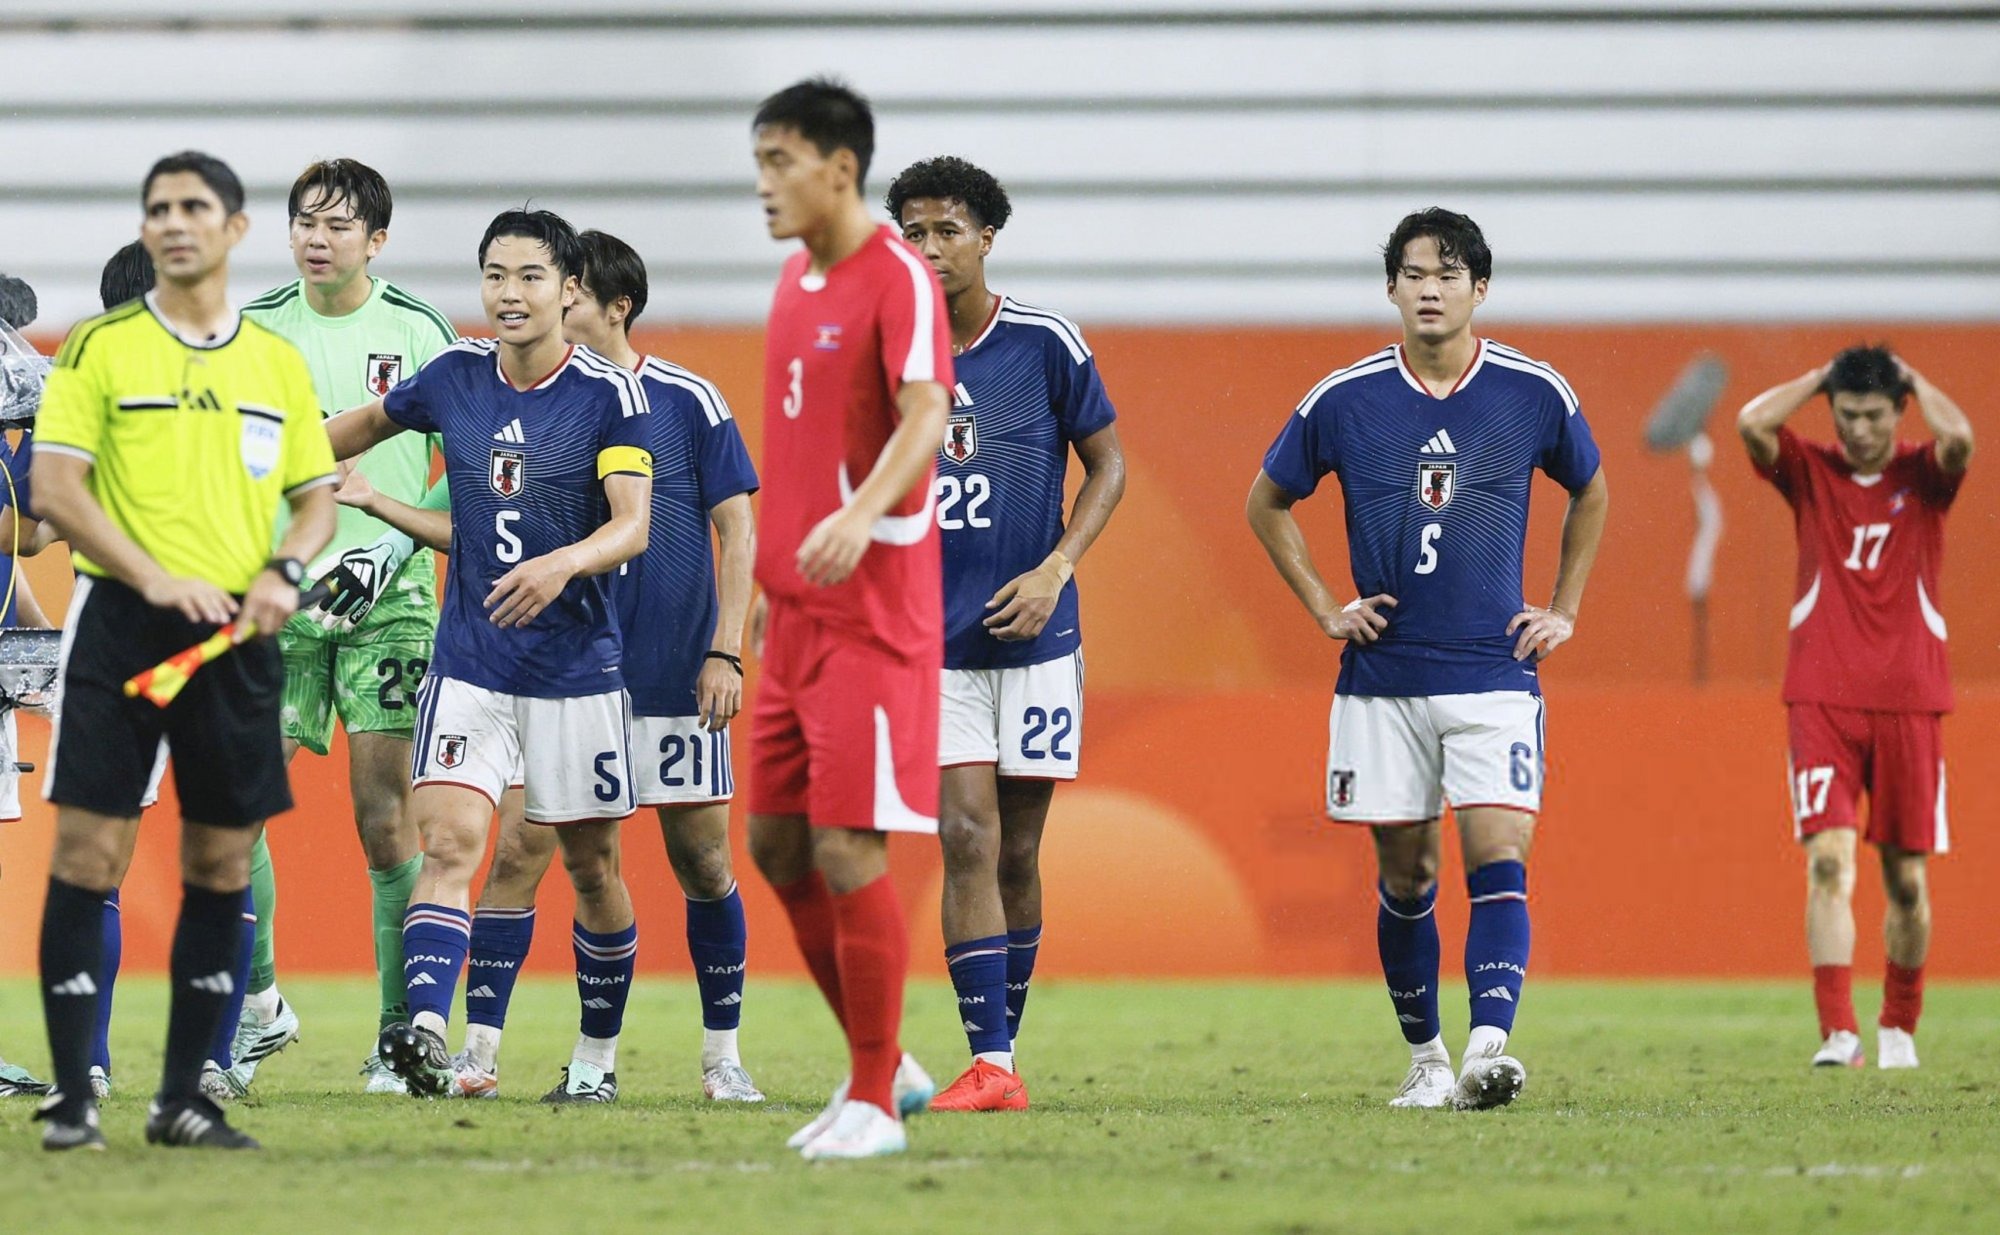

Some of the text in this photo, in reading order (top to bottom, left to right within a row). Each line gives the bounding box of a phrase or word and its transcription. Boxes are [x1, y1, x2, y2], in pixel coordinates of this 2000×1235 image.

[783, 357, 803, 419] 3
[935, 473, 992, 530] 22
[496, 510, 523, 563] 5
[1844, 523, 1892, 571] 17
[351, 600, 371, 621] PRED
[378, 658, 429, 710] 23
[1021, 707, 1072, 761] 22
[594, 751, 620, 802] 5
[660, 734, 703, 787] 21
[1510, 741, 1532, 792] 6
[1797, 766, 1834, 818] 17
[404, 954, 451, 970] APAN
